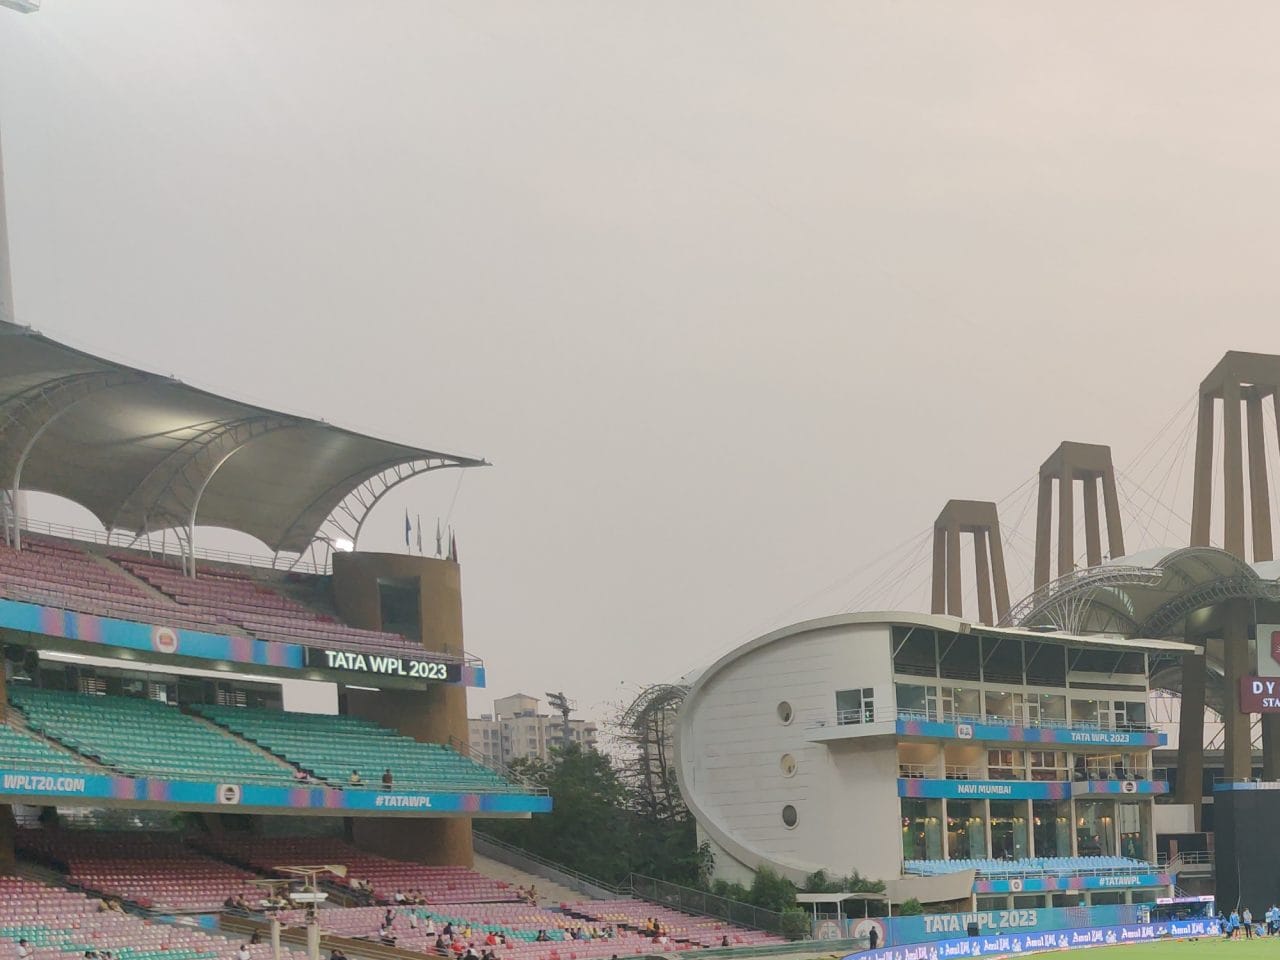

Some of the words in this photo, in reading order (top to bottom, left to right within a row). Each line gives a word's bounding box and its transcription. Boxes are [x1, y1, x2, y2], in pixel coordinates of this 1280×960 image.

[325, 650, 368, 671] TATA
[369, 656, 407, 675] WPL
[409, 661, 447, 679] 2023
[1252, 681, 1263, 694] D
[1266, 681, 1275, 694] Y
[1071, 732, 1091, 741] TATA
[1092, 733, 1109, 742] WPL
[1110, 734, 1129, 743] 2023
[4, 774, 85, 792] WPLT20.COM
[958, 784, 977, 794] NAVI
[978, 784, 1011, 794] MUMBAI
[376, 795, 432, 807] #TATAWPL
[1099, 876, 1141, 886] #TATAWPL
[924, 914, 960, 933] TATA
[962, 912, 997, 931] WPL
[999, 911, 1038, 928] 2023
[1122, 928, 1140, 938] Amul
[1171, 925, 1191, 934] Amul
[1026, 936, 1043, 948] Amul
[1072, 932, 1091, 943] Amul
[984, 939, 999, 951] Amul
